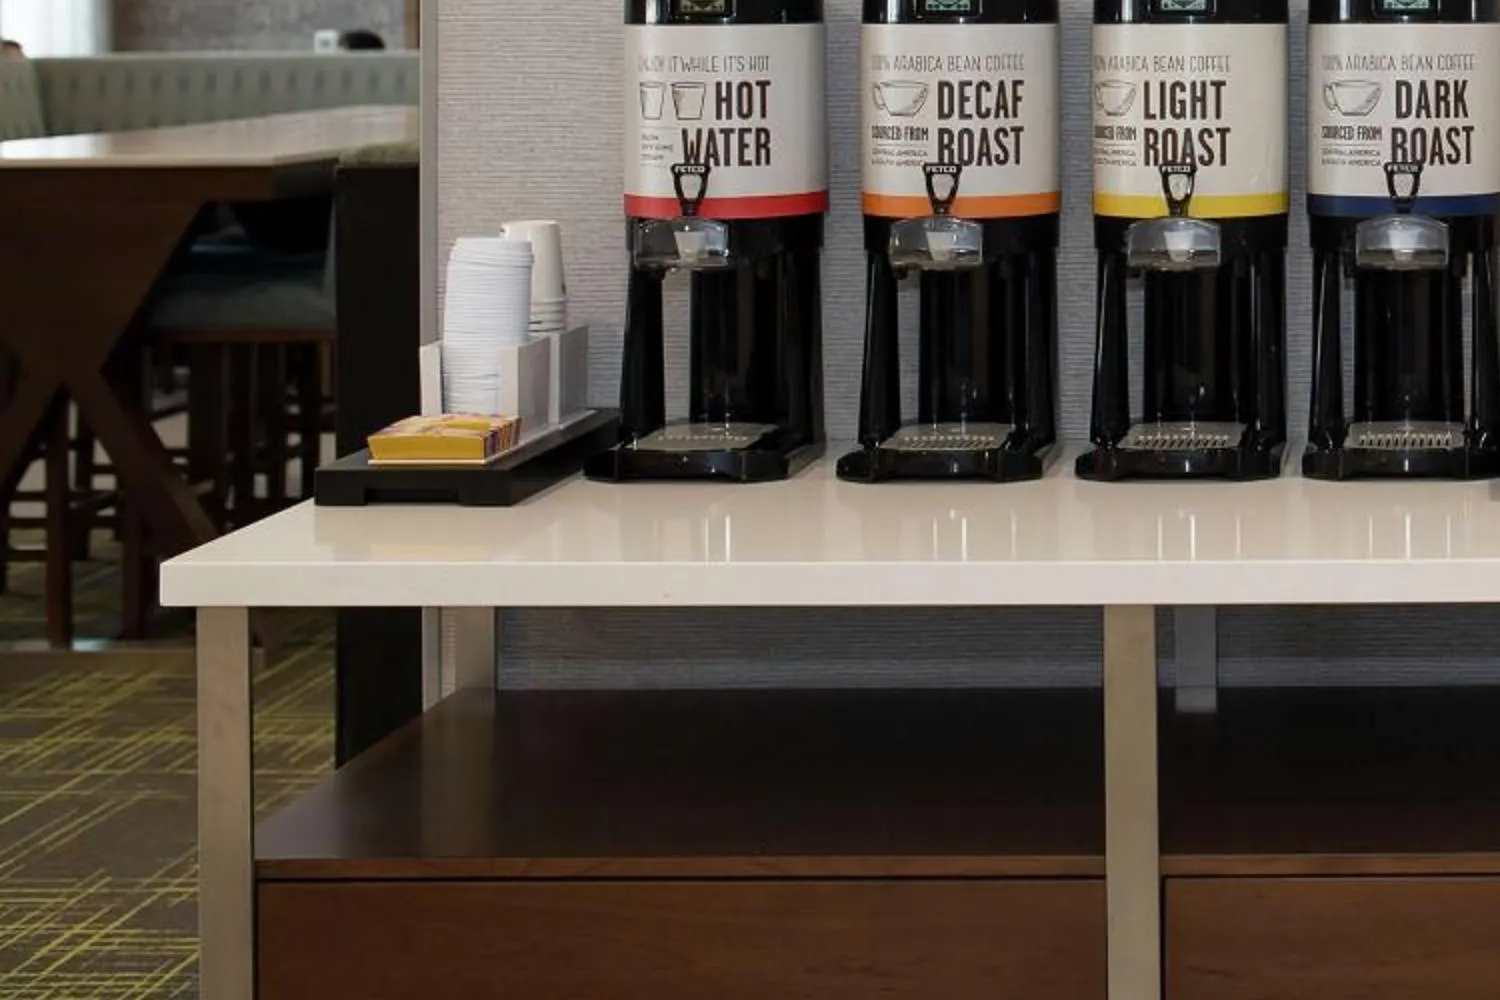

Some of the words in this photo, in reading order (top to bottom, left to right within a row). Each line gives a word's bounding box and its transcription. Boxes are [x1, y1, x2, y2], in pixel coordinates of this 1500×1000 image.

[947, 55, 982, 73] BEAN
[985, 54, 1025, 73] COFFEE
[714, 80, 771, 121] HOT
[937, 80, 1025, 121] DECAF
[1143, 80, 1228, 121] LIGHT
[1395, 79, 1470, 119] DARK
[681, 127, 771, 167] WATER
[937, 127, 1025, 167] ROAST
[1143, 127, 1232, 167] ROAST
[1390, 126, 1475, 166] ROAST
